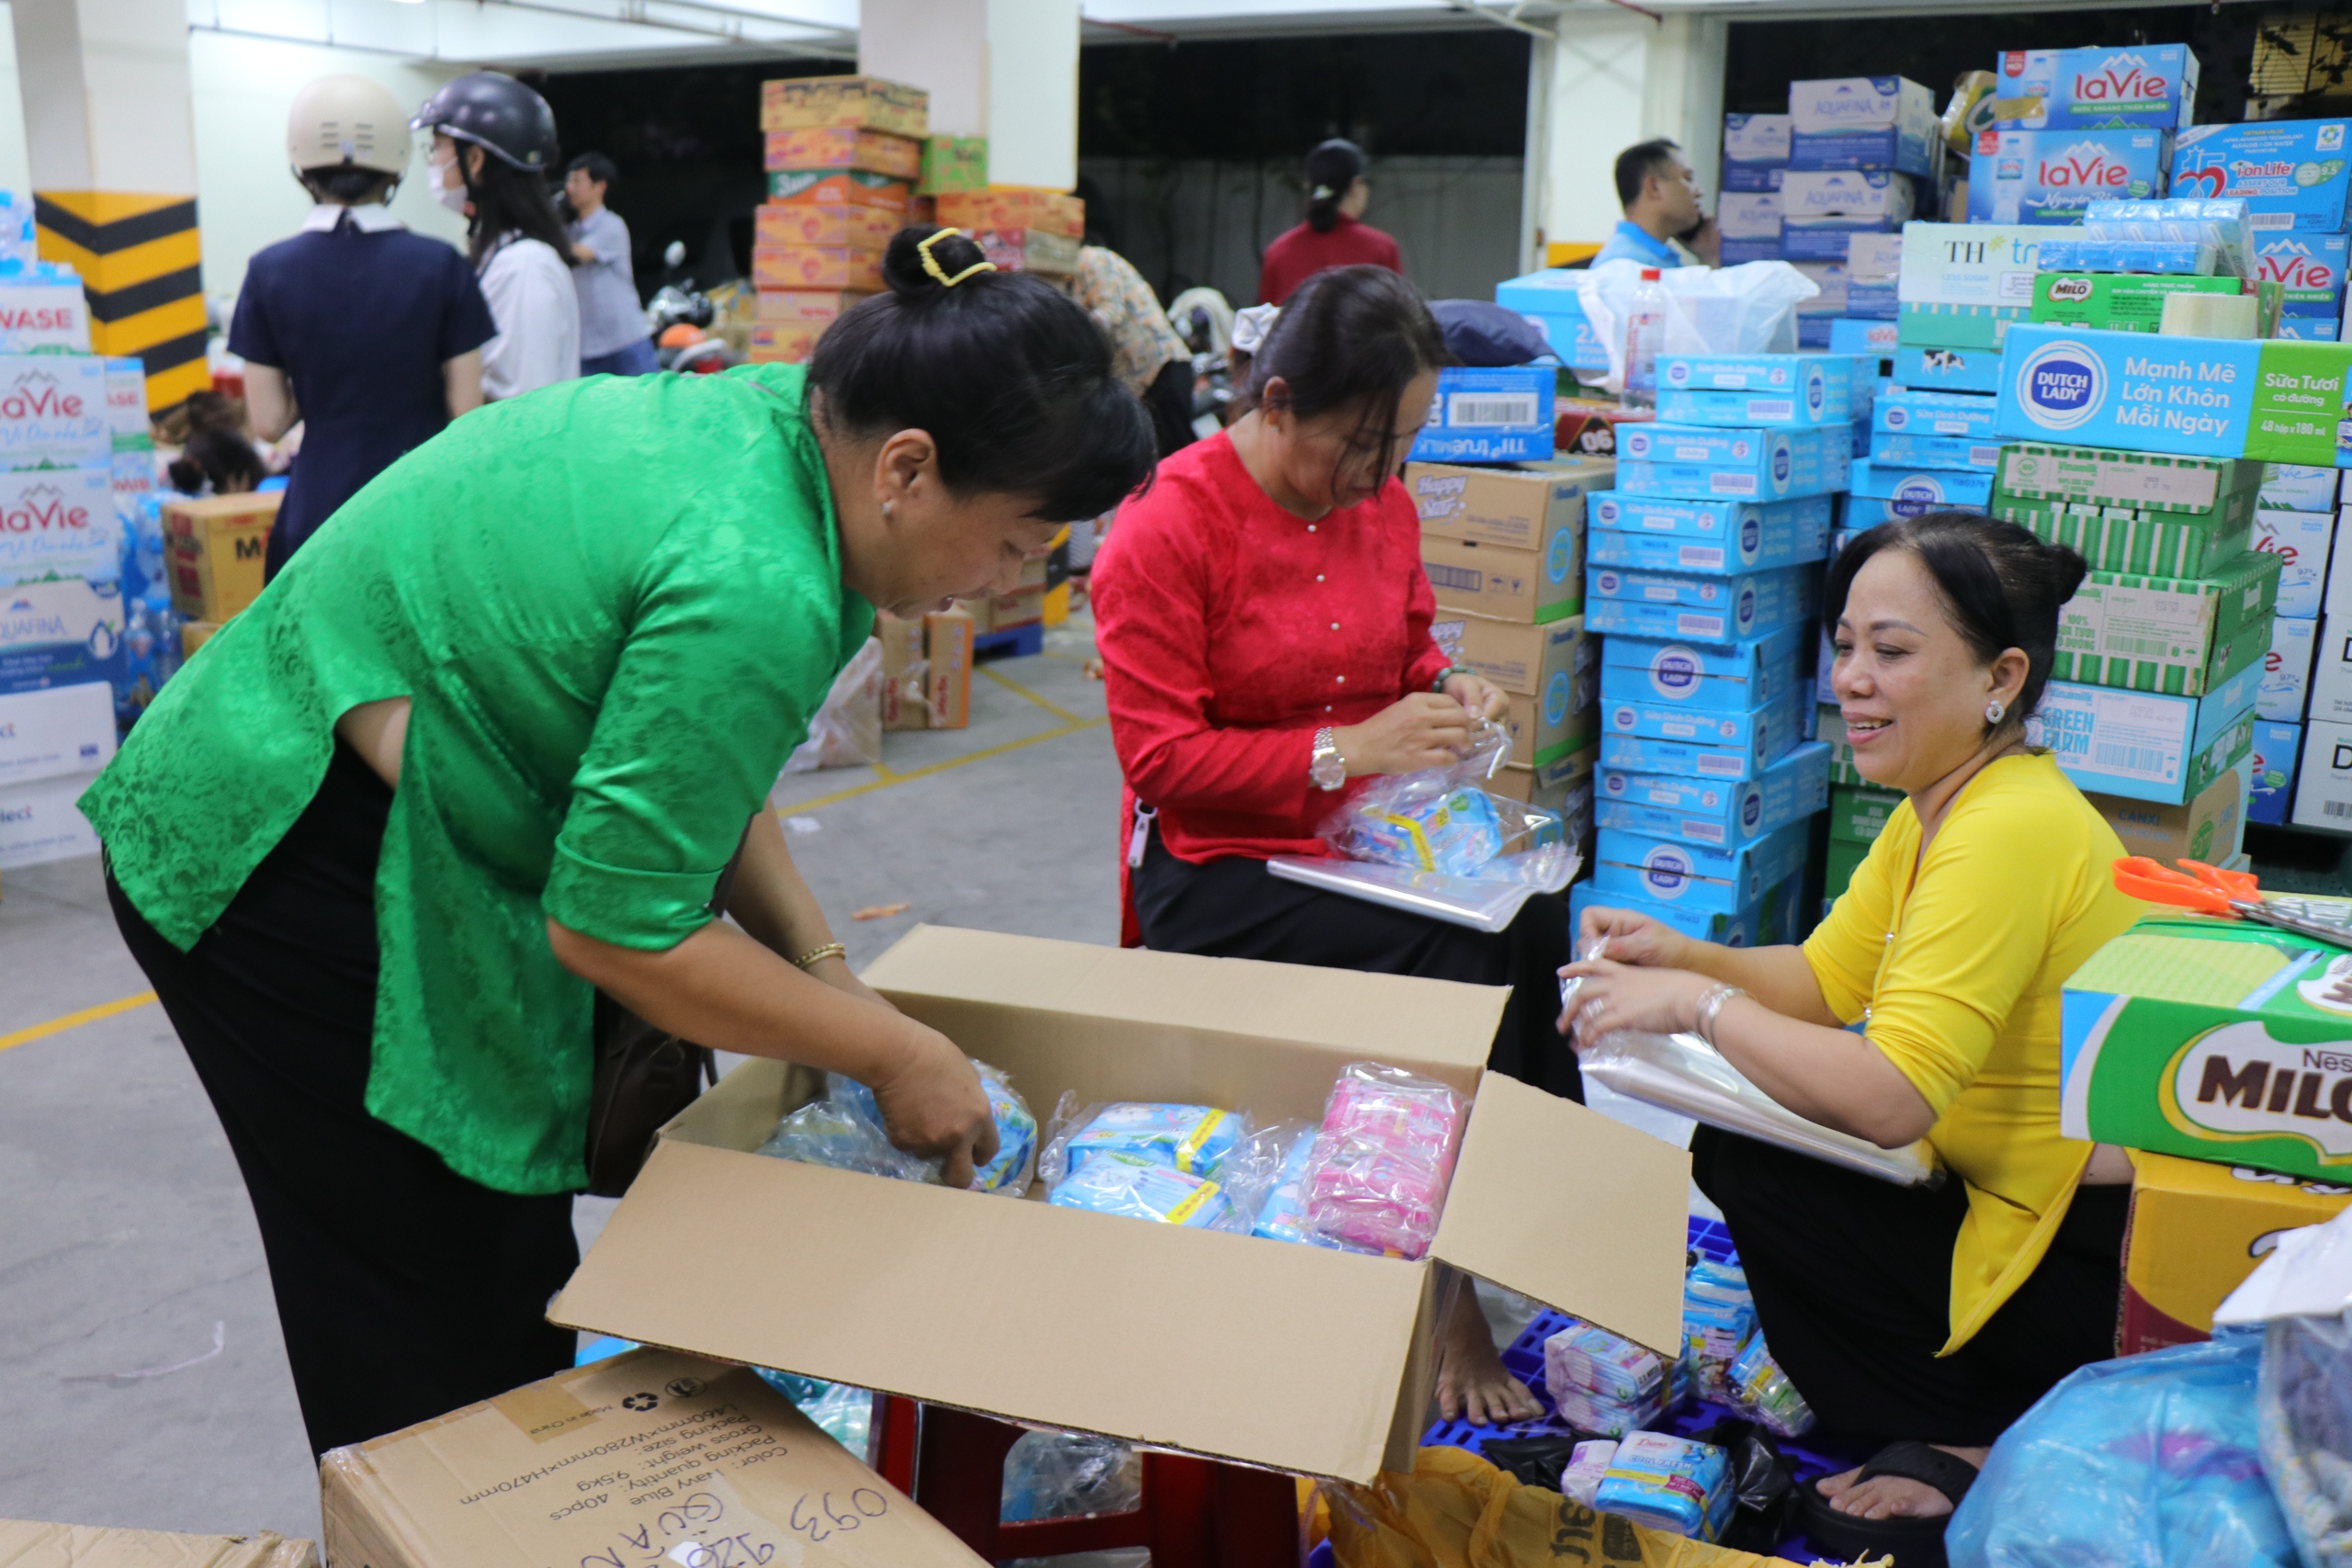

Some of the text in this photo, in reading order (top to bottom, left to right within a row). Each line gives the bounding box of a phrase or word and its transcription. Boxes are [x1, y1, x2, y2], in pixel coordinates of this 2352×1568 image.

[1945, 238, 2038, 264] TH tr
[2257, 255, 2332, 288] Vie
[2055, 284, 2088, 296] MILO
[2037, 371, 2088, 388] DUTCH
[2124, 356, 2236, 383] Mạnh Mẽ
[2265, 372, 2339, 391] Sữa Tươi
[2041, 386, 2079, 401] LADY
[2121, 381, 2231, 408] Lớn Khôn
[2288, 393, 2324, 407] đường
[2116, 404, 2230, 438] Mỗi Ngày
[2261, 420, 2274, 432] 48
[2042, 706, 2095, 733] GREEN
[2042, 728, 2090, 755] FARM
[679, 1411, 751, 1443] Packing
[638, 1422, 763, 1471] Gross weight:
[729, 1444, 788, 1470] Color:
[621, 1431, 777, 1493] Packing quantity:
[577, 1468, 630, 1494] 9.5kg
[549, 1492, 611, 1522] 40pcs
[629, 1487, 670, 1507] Blue
[790, 1487, 888, 1543] 093
